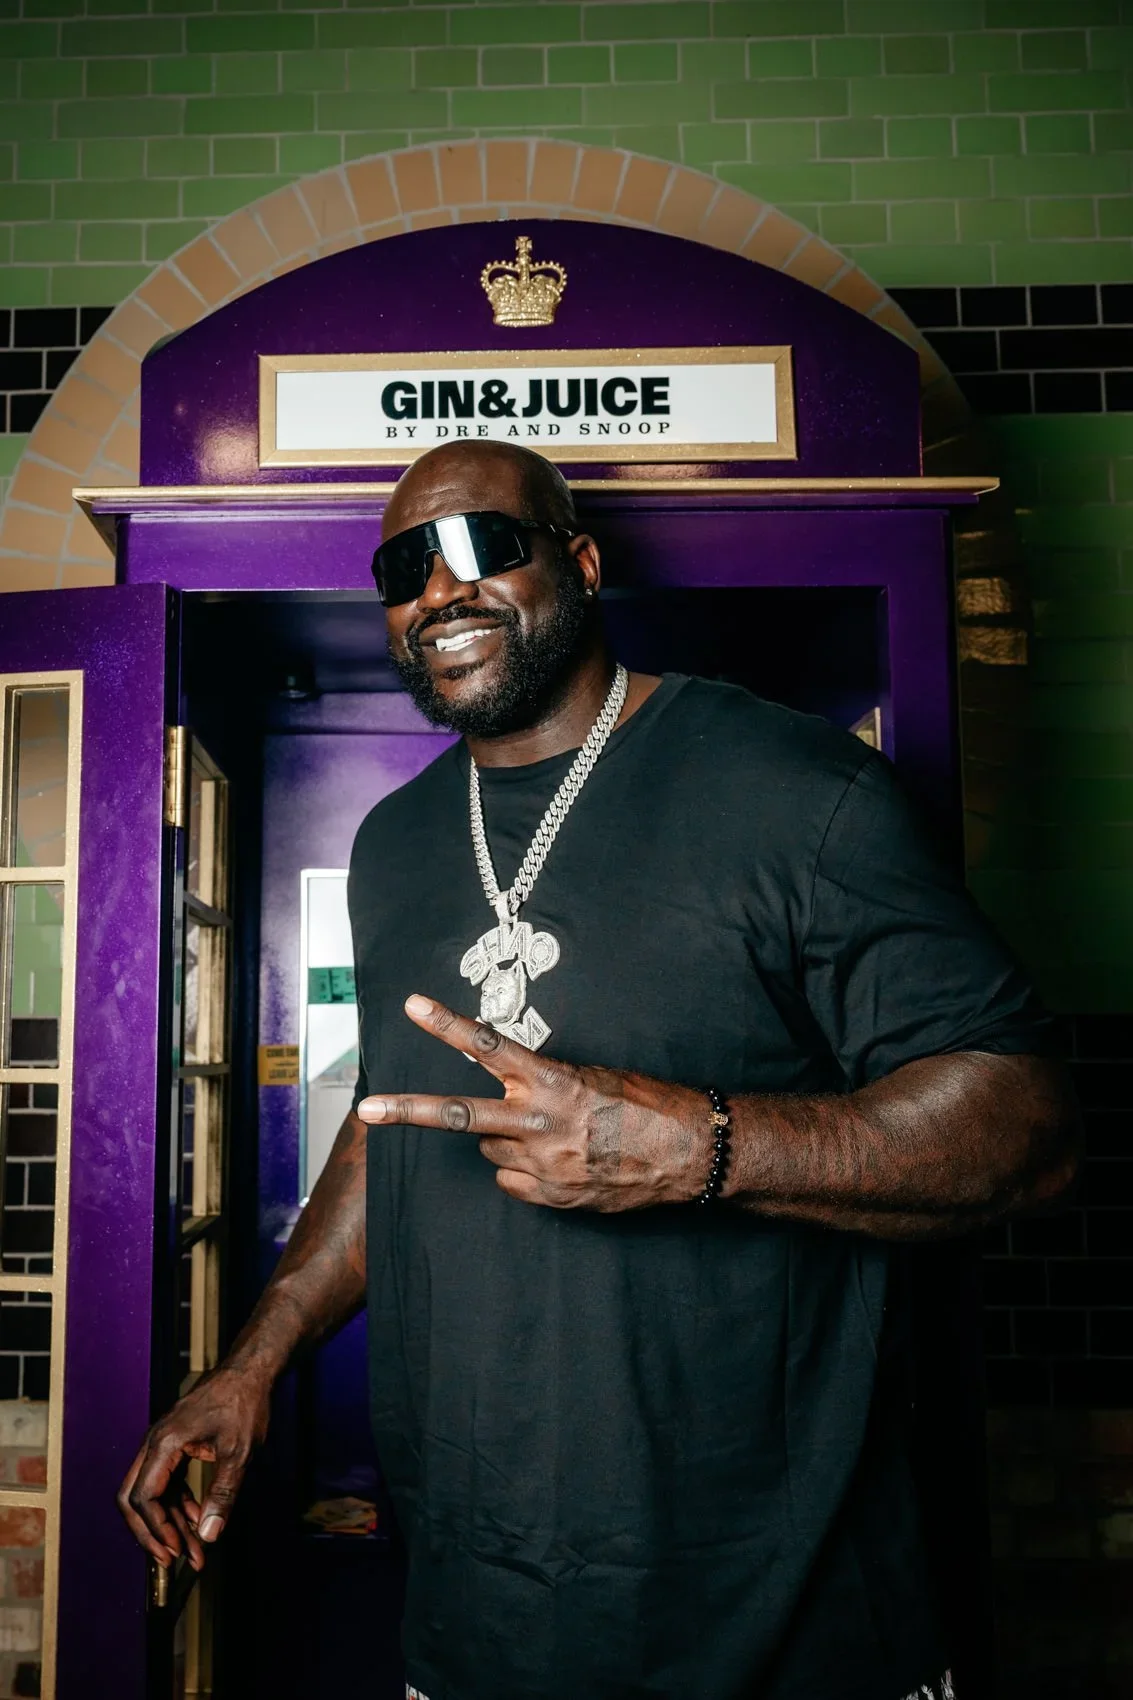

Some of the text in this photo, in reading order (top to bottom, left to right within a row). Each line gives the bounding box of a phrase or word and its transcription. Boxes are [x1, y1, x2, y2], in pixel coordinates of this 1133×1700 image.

[381, 377, 670, 420] GIN&JUICE
[386, 422, 670, 438] BY DRE AND SNOOP
